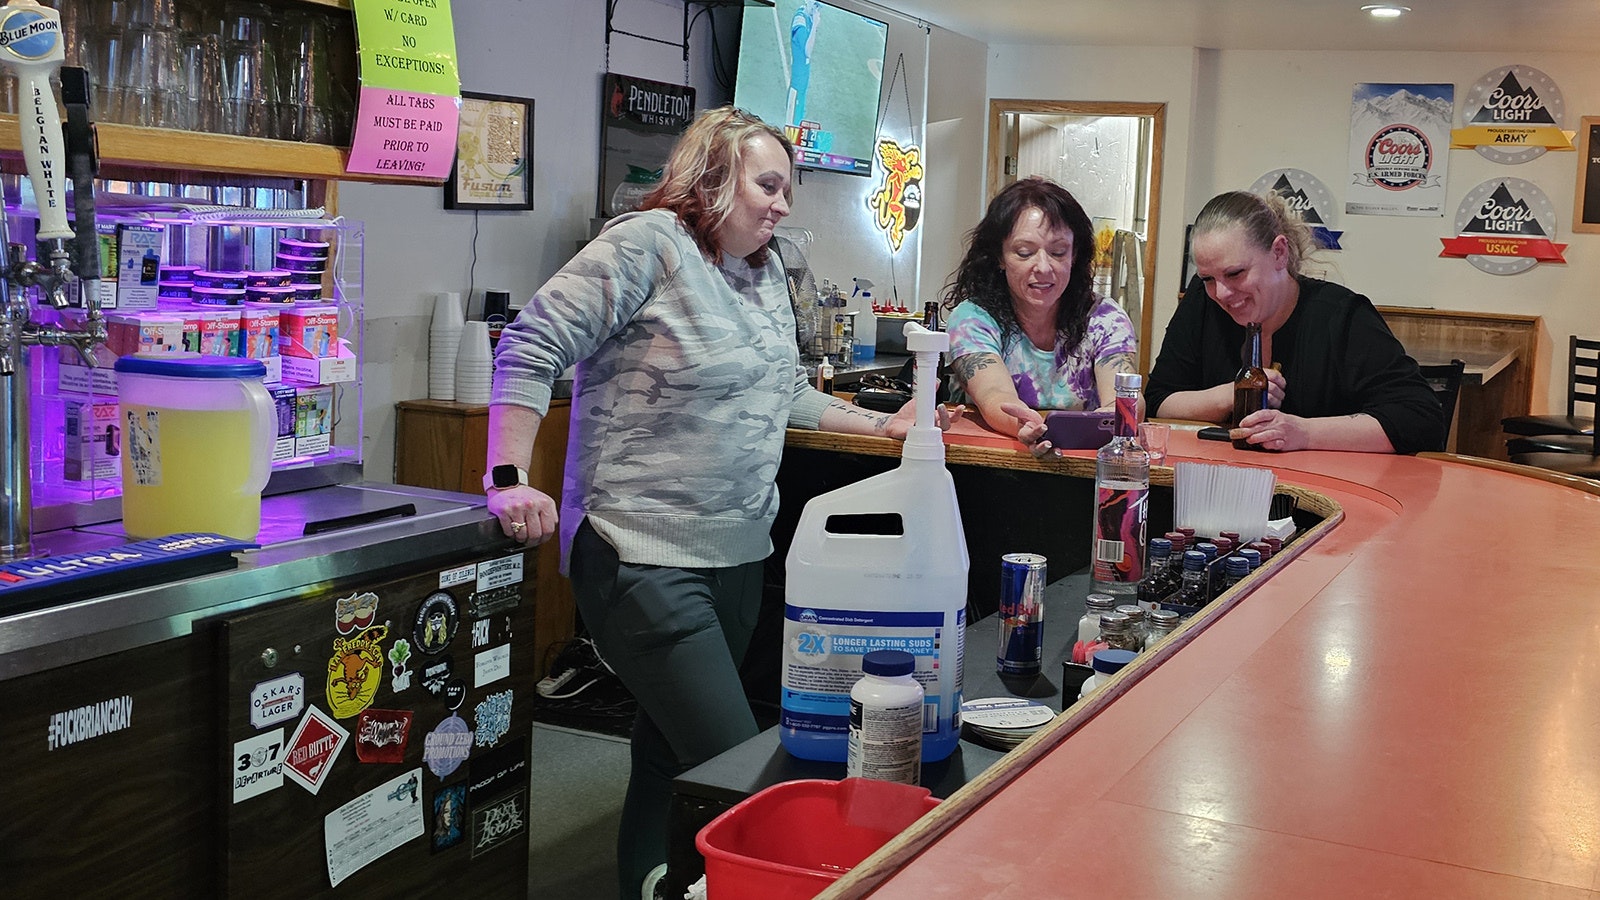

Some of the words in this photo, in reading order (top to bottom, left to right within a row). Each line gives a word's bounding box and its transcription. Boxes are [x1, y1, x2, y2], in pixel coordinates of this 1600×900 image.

[384, 8, 399, 22] W/
[400, 12, 428, 26] CARD
[0, 30, 28, 46] BLUE
[29, 20, 58, 37] MOON
[402, 35, 416, 48] NO
[375, 54, 445, 75] EXCEPTIONS!
[386, 94, 406, 107] ALL
[408, 96, 435, 109] TABS
[628, 85, 691, 120] PENDLETON
[1483, 87, 1545, 110] Coors
[33, 87, 50, 154] BELGIAN
[641, 114, 676, 127] WHISKY
[1493, 109, 1533, 120] LIGHT
[373, 116, 401, 129] MUST
[403, 118, 417, 130] BE
[419, 120, 443, 132] PAID
[383, 139, 413, 152] PRIOR
[416, 142, 429, 153] TO
[1378, 137, 1422, 156] Coors
[1494, 134, 1528, 143] ARMY
[375, 159, 426, 171] LEAVING!
[1378, 154, 1419, 165] LIGHT
[40, 160, 57, 208] WHITE
[1475, 198, 1537, 222] Coors
[1484, 220, 1524, 231] LIGHT
[1485, 243, 1520, 254] USMC
[17, 552, 143, 577] ULTRA
[797, 632, 826, 654] 2X
[833, 637, 867, 646] LONGER
[870, 638, 906, 647] LASTING
[908, 639, 932, 648] SUDS
[843, 645, 865, 653] SAVE
[262, 702, 293, 718] LAGER
[48, 695, 133, 751] #FUCKBRIANGRAY
[425, 733, 456, 747] GROUND
[292, 745, 307, 766] RED
[308, 734, 334, 757] BUTTE
[423, 745, 471, 760] PROMOTIONS
[235, 763, 283, 789] DEPARTURE
